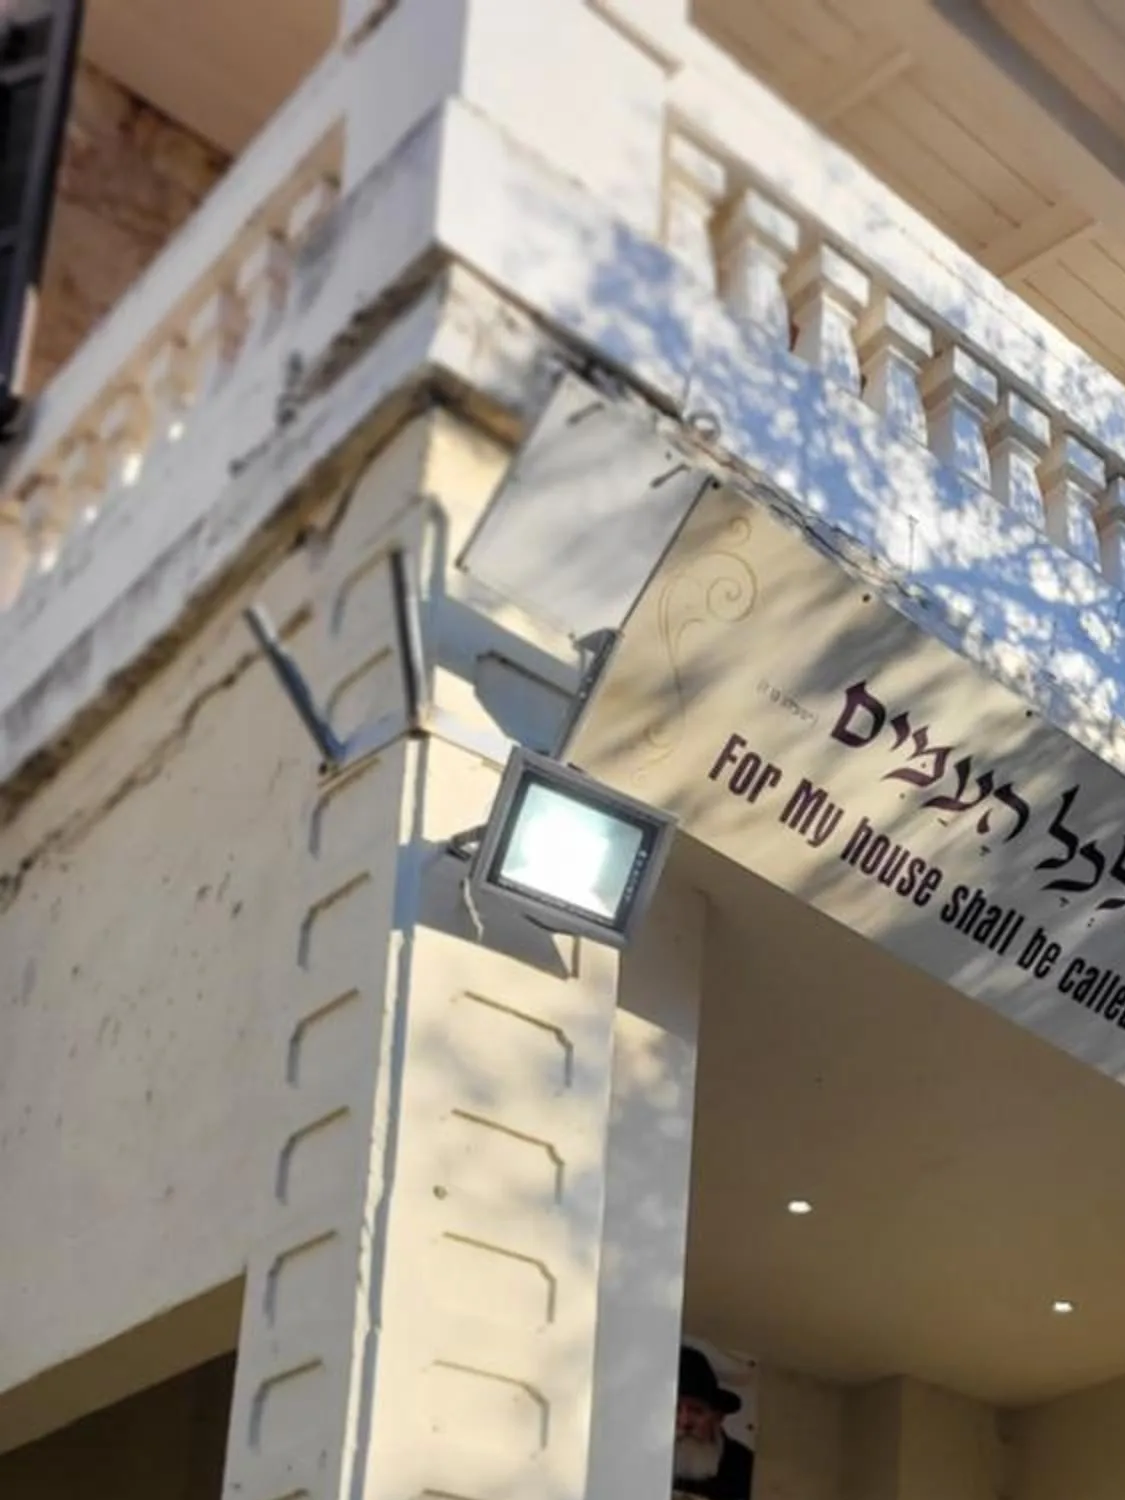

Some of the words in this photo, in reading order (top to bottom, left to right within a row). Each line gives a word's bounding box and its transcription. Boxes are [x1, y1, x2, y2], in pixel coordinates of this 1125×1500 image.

[707, 732, 783, 804] For
[778, 778, 845, 848] My
[840, 816, 944, 907] house
[939, 884, 1025, 957] shall
[1016, 927, 1062, 980] be
